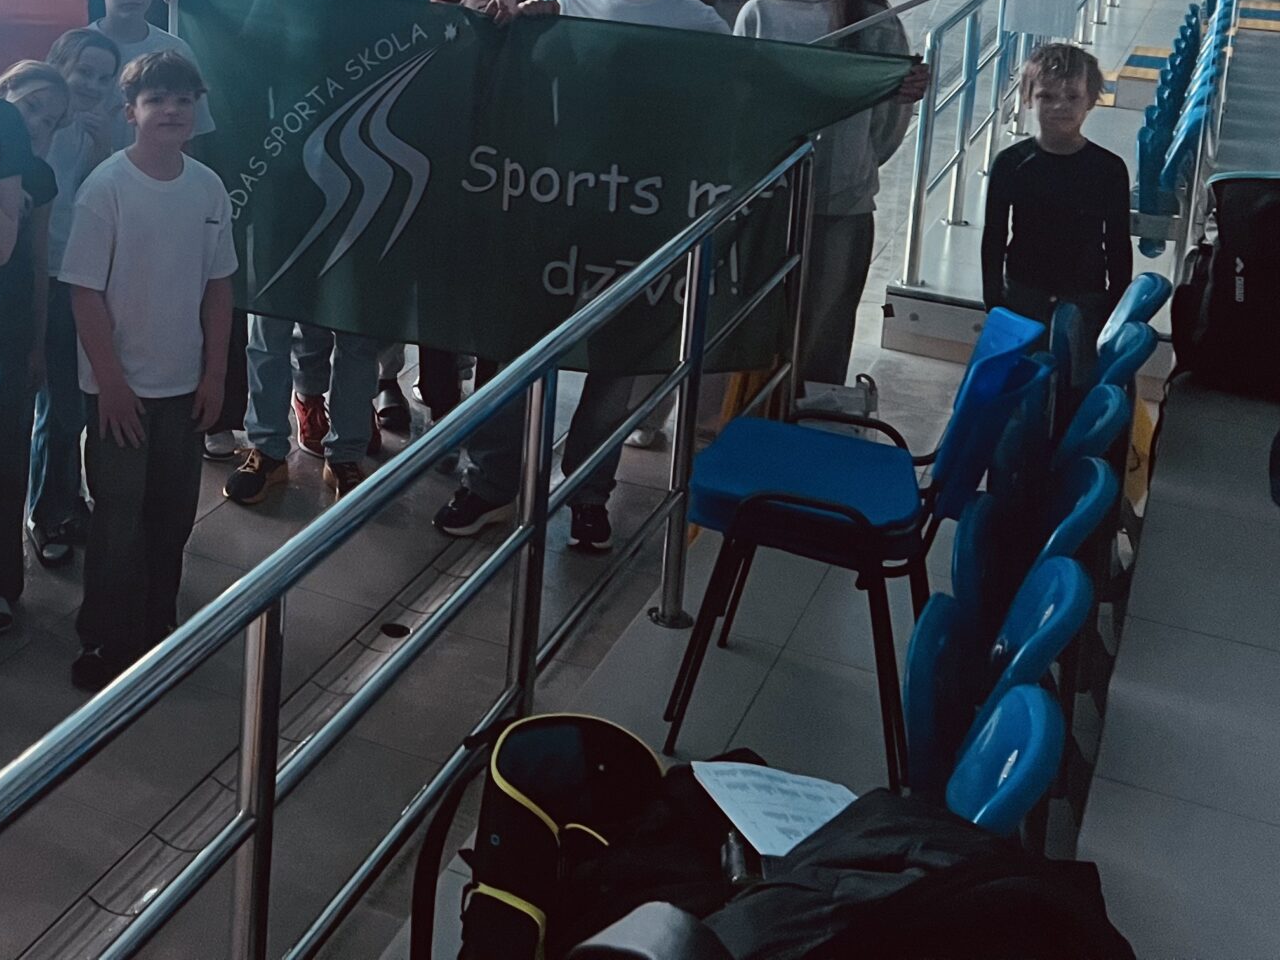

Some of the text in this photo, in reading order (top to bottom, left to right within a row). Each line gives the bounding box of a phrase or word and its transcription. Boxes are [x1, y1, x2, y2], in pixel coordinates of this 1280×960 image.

[263, 77, 345, 157] SPORTA
[345, 23, 429, 80] SKOLA
[461, 144, 663, 216] Sports
